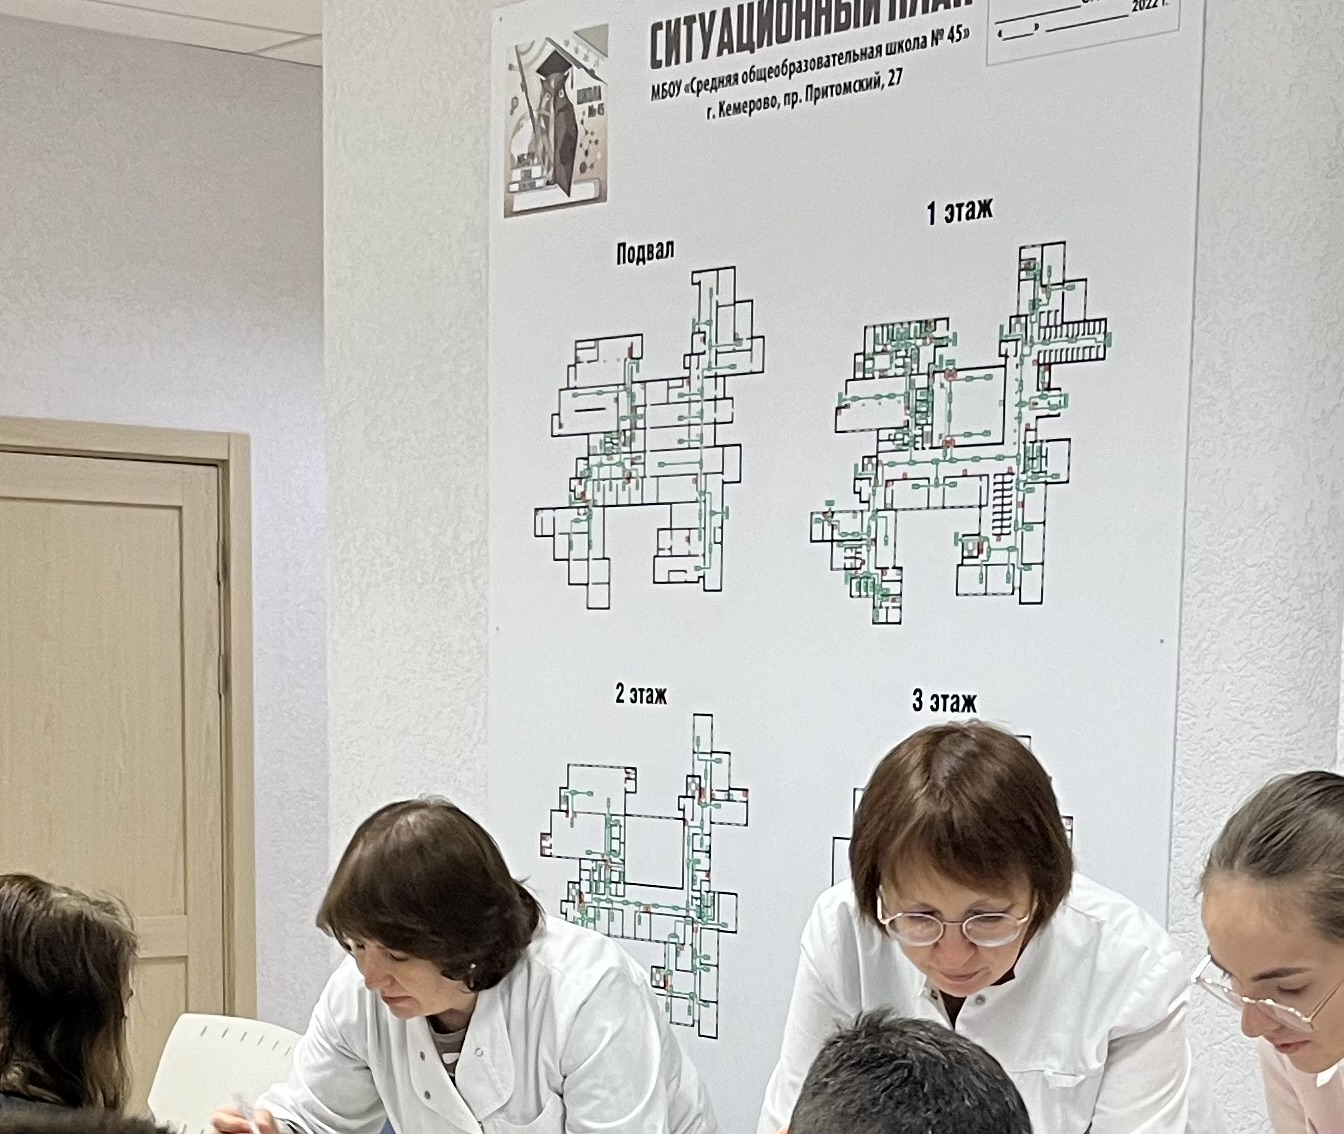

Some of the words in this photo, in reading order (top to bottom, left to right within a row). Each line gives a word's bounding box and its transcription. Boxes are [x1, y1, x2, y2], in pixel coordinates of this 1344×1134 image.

[651, 79, 682, 101] МБОУ
[684, 72, 738, 97] «Средняя
[741, 44, 883, 84] общеобразовательная
[885, 35, 927, 56] школа
[947, 24, 970, 43] 45»
[707, 106, 716, 120] г.
[719, 95, 781, 118] Кемерово,
[783, 92, 802, 109] пр.
[805, 71, 885, 105] Притомский,
[888, 67, 903, 87] 27
[927, 200, 935, 225] 1
[944, 198, 994, 224] этаж
[617, 240, 674, 266] Подвал
[616, 681, 624, 703] 2
[629, 687, 667, 704] этаж
[912, 688, 923, 712] 3
[929, 693, 977, 713] этаж
